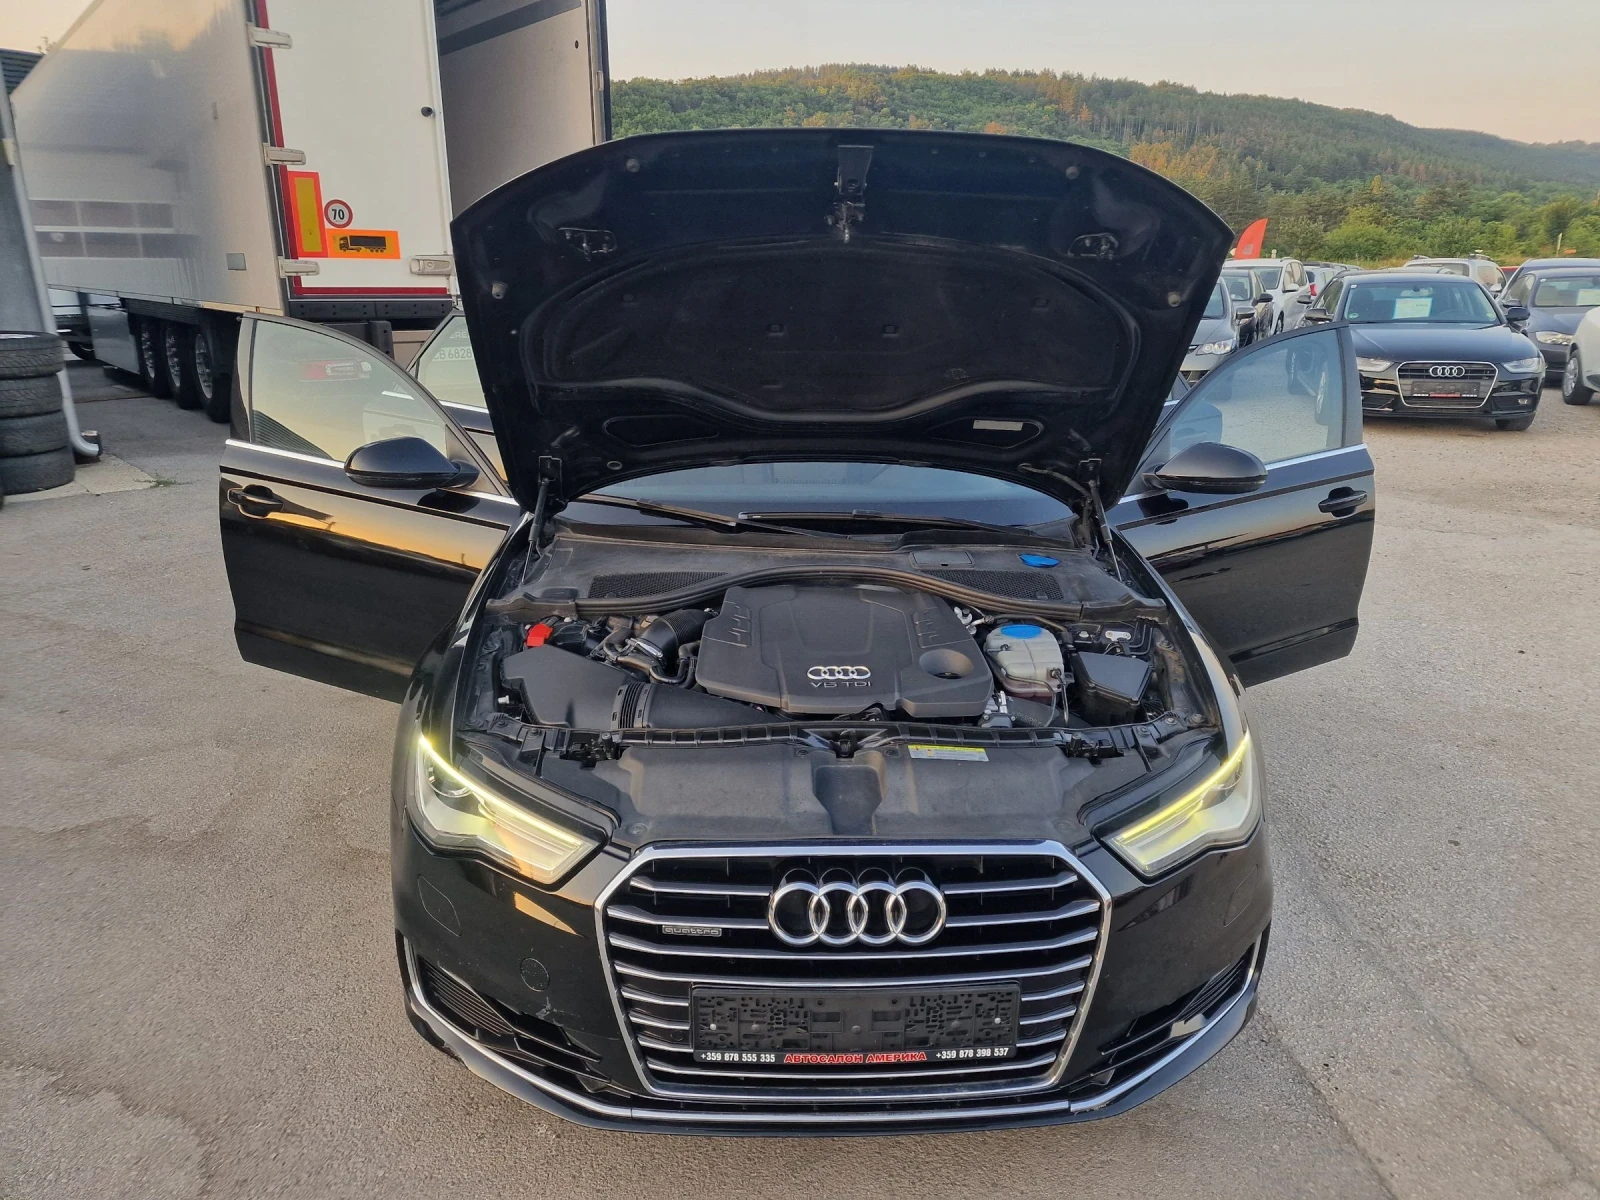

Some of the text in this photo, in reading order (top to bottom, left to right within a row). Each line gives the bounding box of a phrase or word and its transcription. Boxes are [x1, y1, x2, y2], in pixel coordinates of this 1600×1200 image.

[331, 208, 345, 220] 70
[448, 348, 473, 359] 6828
[665, 927, 719, 935] quattro
[700, 1052, 776, 1063] +359 878 555 335
[784, 1051, 927, 1064] АВТОСАЛОН АМЕРИКА
[935, 1047, 1009, 1059] +359 878 398 537
